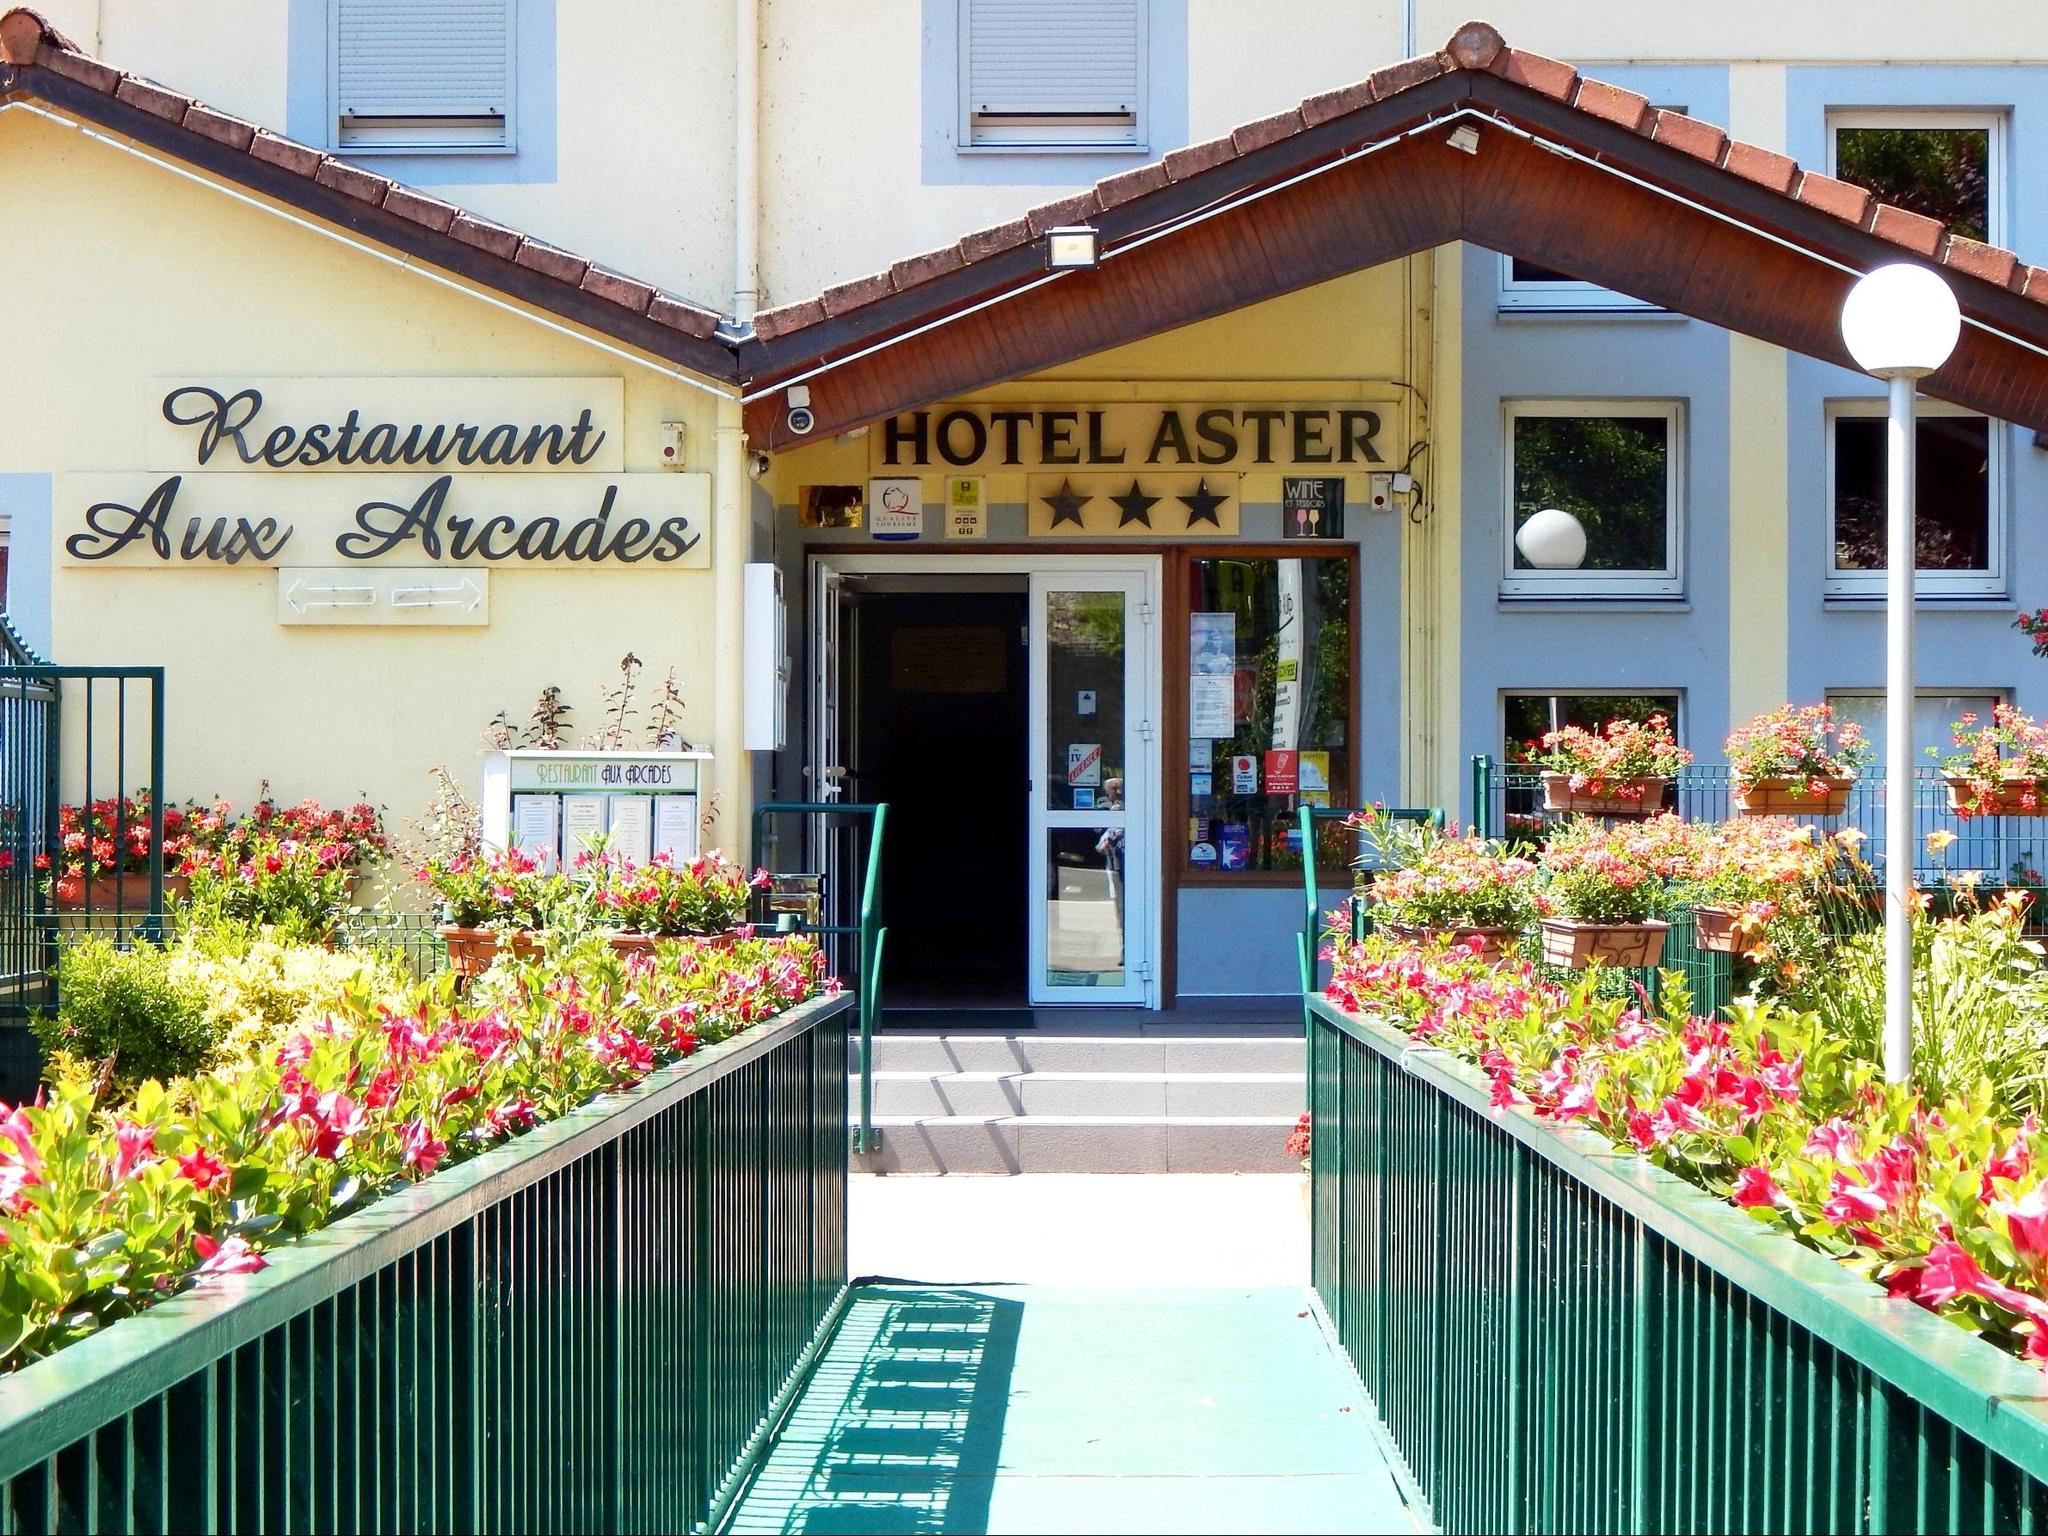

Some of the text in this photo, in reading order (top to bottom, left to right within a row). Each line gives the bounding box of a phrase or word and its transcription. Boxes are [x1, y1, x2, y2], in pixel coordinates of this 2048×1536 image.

[162, 386, 606, 468] Restaurant
[883, 409, 1385, 466] HOTEL ASTER
[1285, 480, 1324, 499] WINE
[65, 475, 702, 565] Aux Arcades
[536, 764, 672, 785] RESTAURANT AUX ARCADES
[1070, 753, 1082, 763] IV
